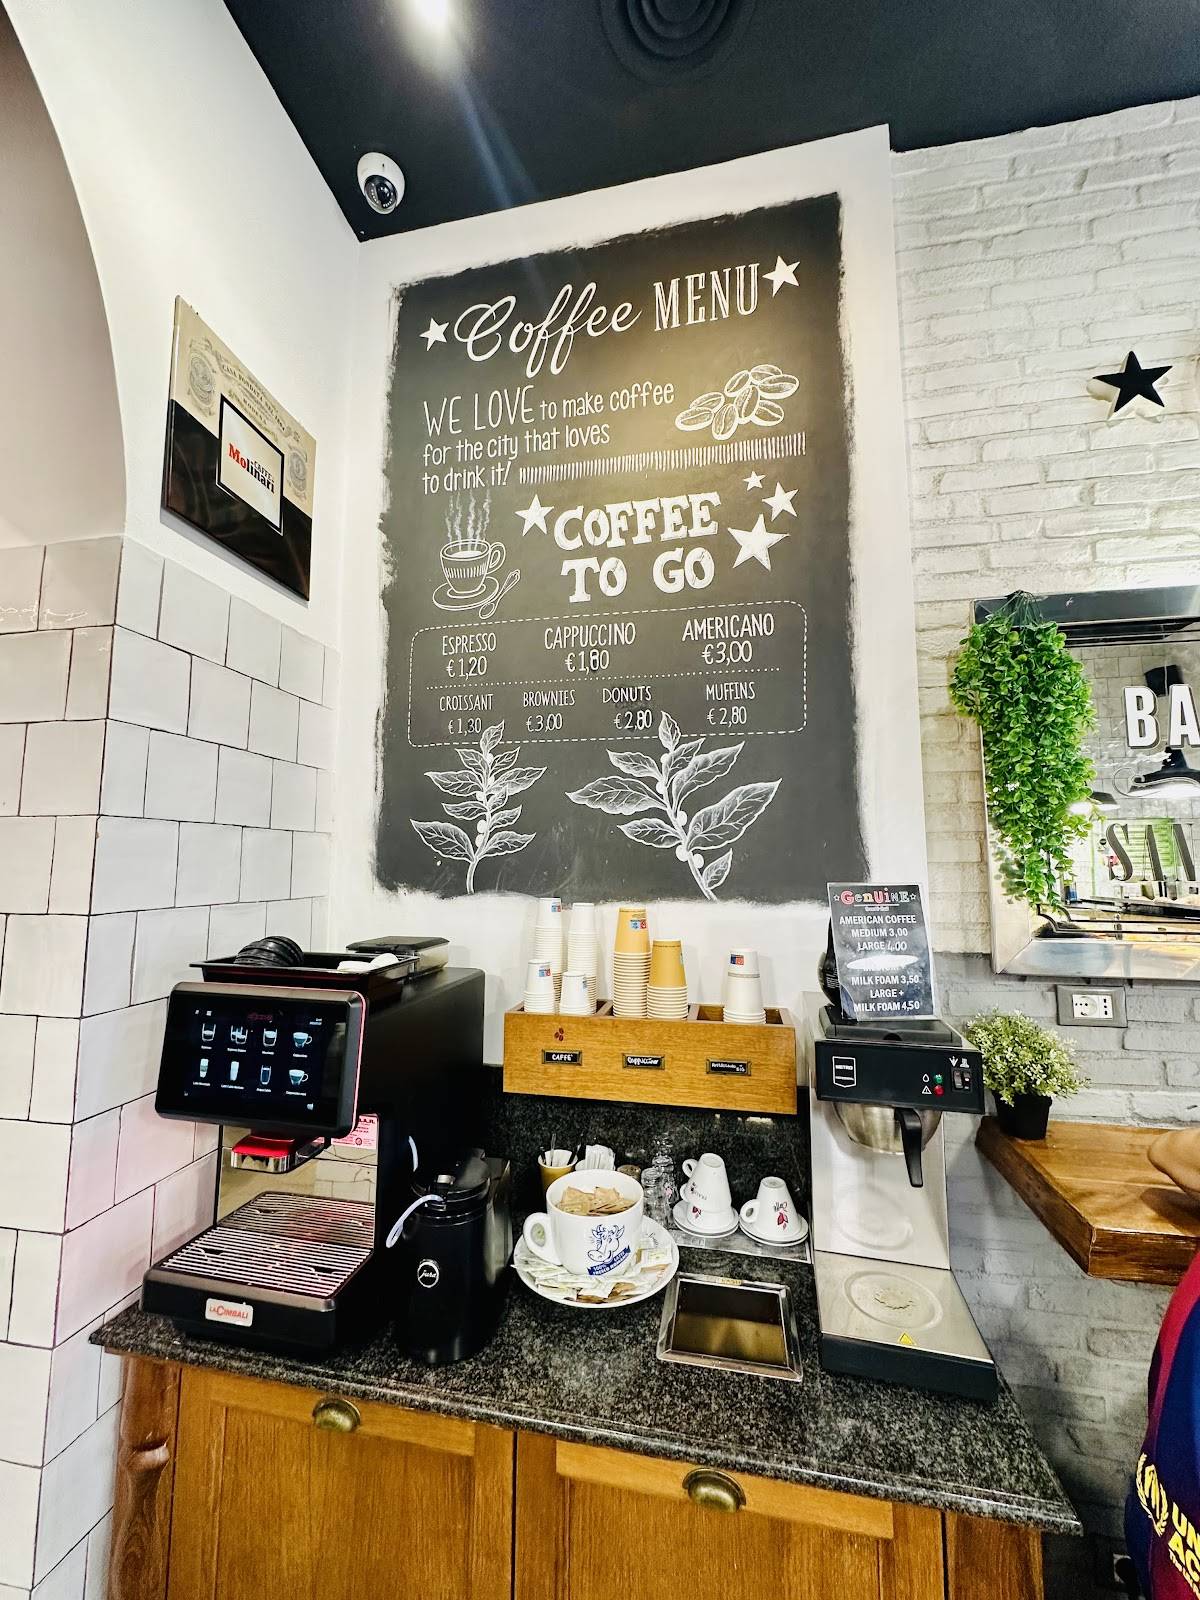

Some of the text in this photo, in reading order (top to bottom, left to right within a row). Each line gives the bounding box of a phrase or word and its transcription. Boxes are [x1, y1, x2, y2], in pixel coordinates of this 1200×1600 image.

[453, 263, 760, 379] Coffee MENU
[423, 381, 675, 437] WE LOVE to make coffee
[423, 423, 610, 467] for the city that loves
[228, 442, 275, 494] Molinari
[422, 461, 512, 495] to drink it!
[553, 491, 722, 551] COFFEE
[560, 546, 716, 603] TO GO
[544, 622, 637, 650] CAPPUCCINO
[681, 613, 775, 642] AMERICANO
[442, 632, 497, 656] ESPRESSO
[523, 689, 576, 708] BROWNIES
[602, 685, 652, 704] DONUTS
[706, 681, 756, 701] MUFFINS
[439, 693, 494, 712] CROISSANT
[839, 914, 917, 925] AMERICAN COFFEE
[851, 927, 908, 938] MEDIUM 3,00
[857, 941, 885, 952] LARGE
[851, 974, 919, 986] MILK FOAM 3,50
[870, 988, 898, 999] LARGE
[853, 1000, 920, 1012] MILK FOAM 4,50
